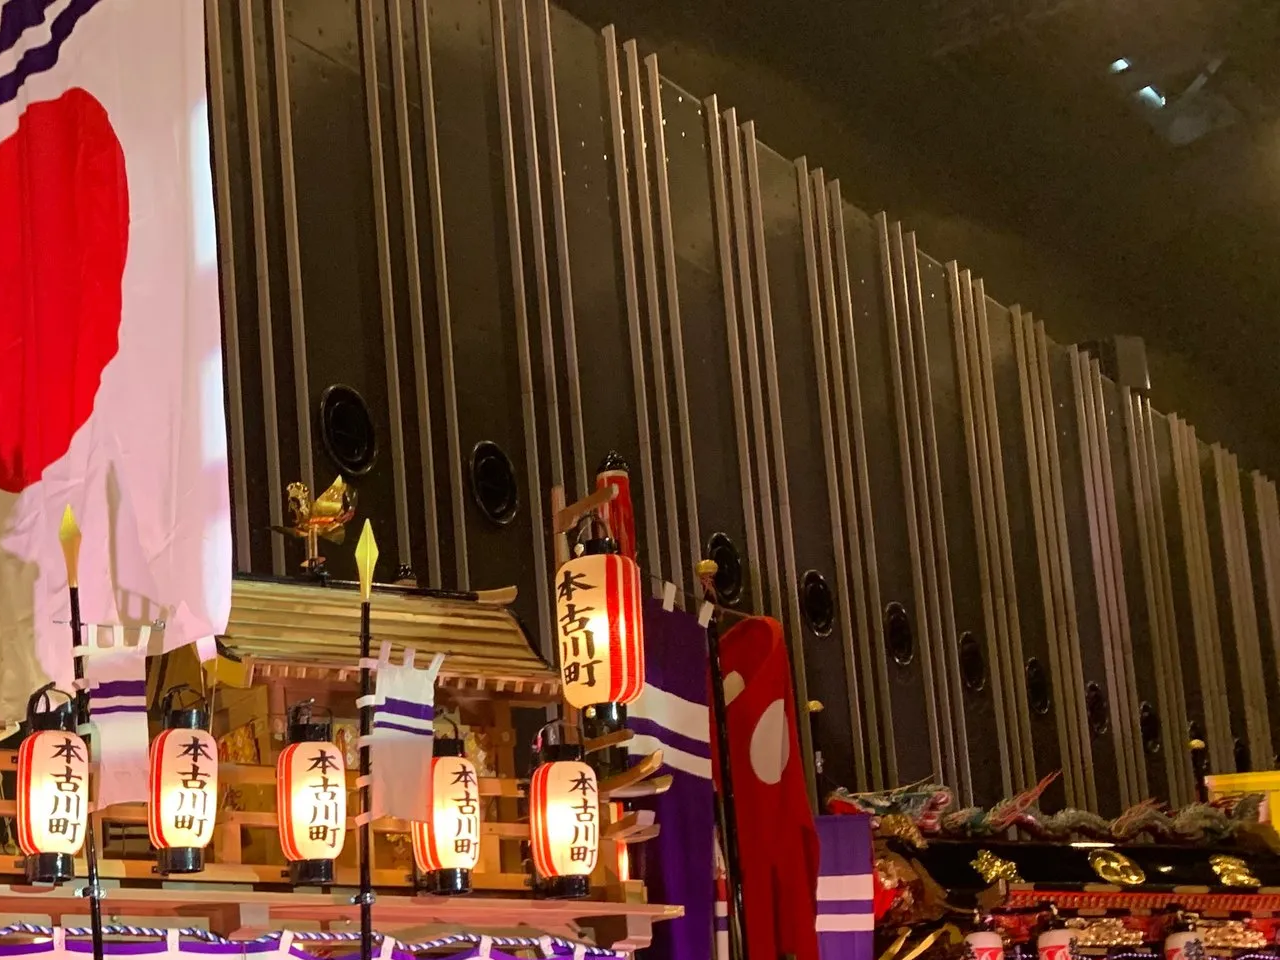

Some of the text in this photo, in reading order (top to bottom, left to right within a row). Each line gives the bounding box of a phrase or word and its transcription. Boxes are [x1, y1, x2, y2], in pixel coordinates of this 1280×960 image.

[558, 570, 603, 688] 本古川町
[47, 738, 84, 845] 本古川町
[174, 735, 214, 837] 本古川町
[306, 749, 342, 848] 本古川町
[450, 763, 479, 857] 本古川町
[568, 771, 597, 869] 本古川町
